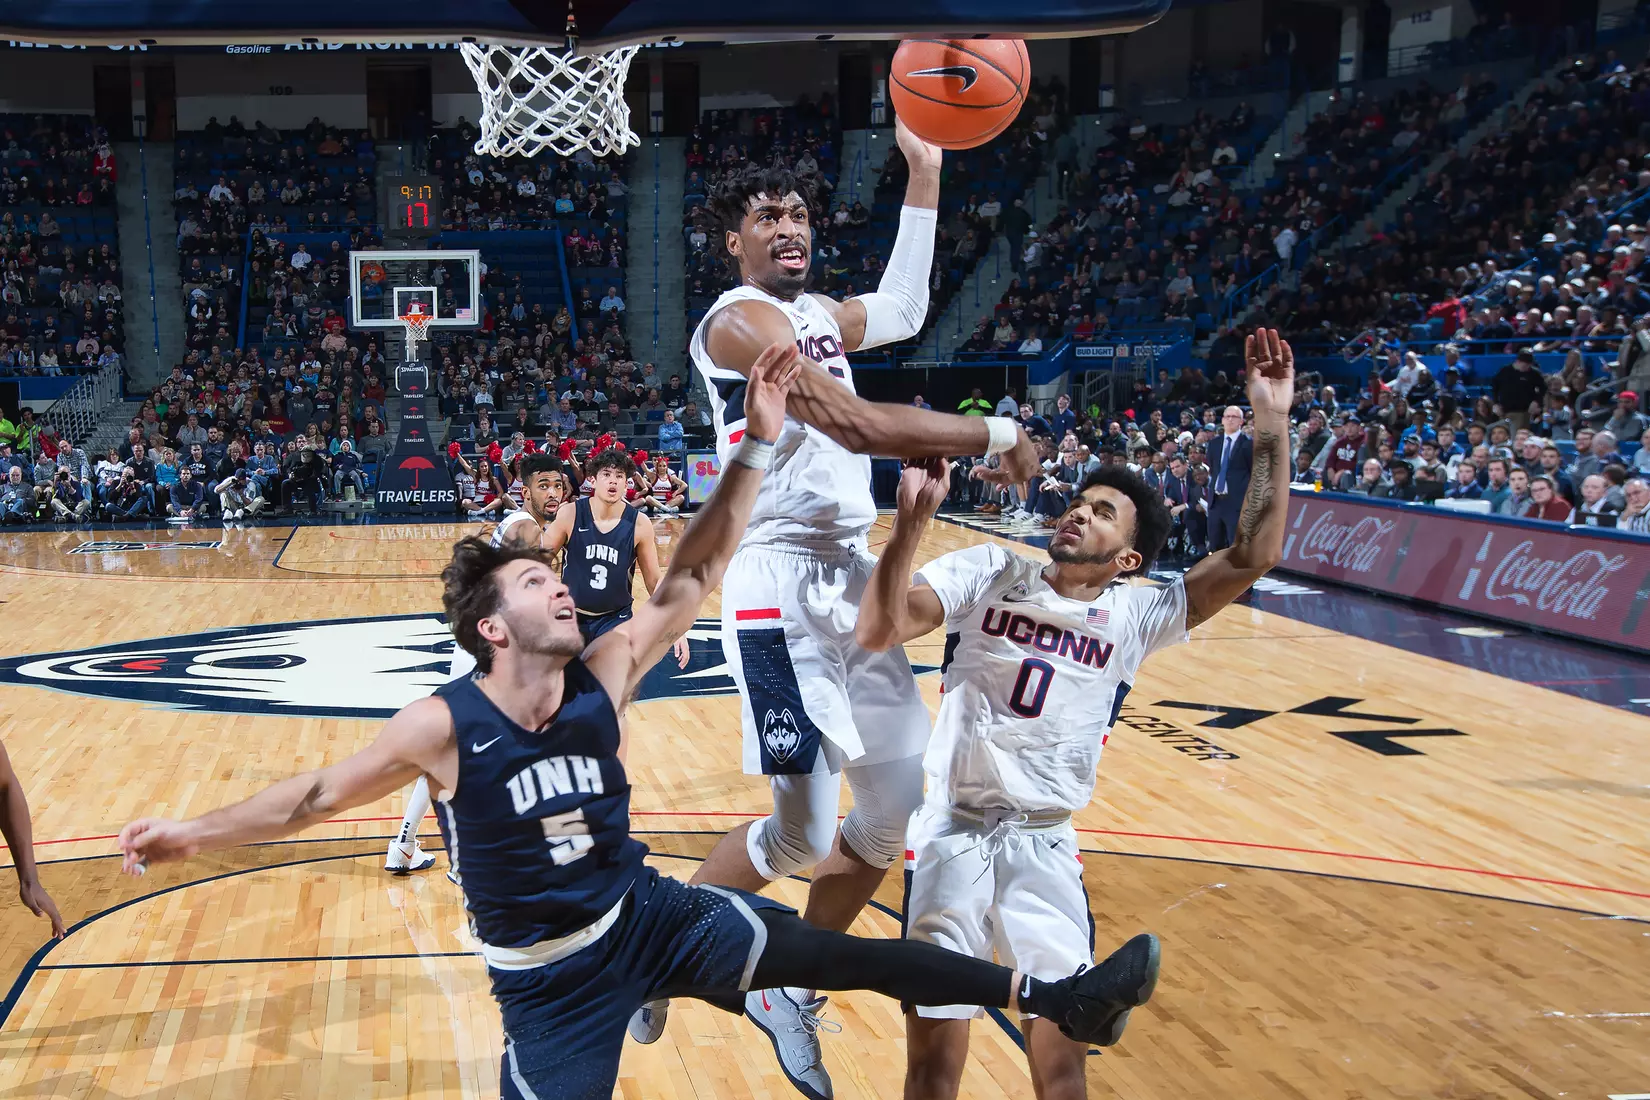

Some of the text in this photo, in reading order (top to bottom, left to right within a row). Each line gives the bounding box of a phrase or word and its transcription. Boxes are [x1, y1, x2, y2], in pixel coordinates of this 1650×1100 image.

[226, 44, 272, 54] Gasoline
[401, 185, 431, 199] 9:17
[407, 202, 428, 227] 17
[1077, 348, 1091, 356] BUD
[1092, 348, 1112, 356] LIGHT
[378, 490, 455, 503] TRAVELERS
[585, 543, 619, 566] UNH
[1299, 509, 1396, 573] Coca-Cola
[589, 563, 608, 590] 3
[1484, 540, 1633, 621] Coca-Cola
[980, 606, 1114, 670] UCONN
[1008, 656, 1057, 720] 0
[1116, 714, 1241, 761] CENTER
[506, 754, 604, 816] UNH
[539, 806, 596, 867] 5
